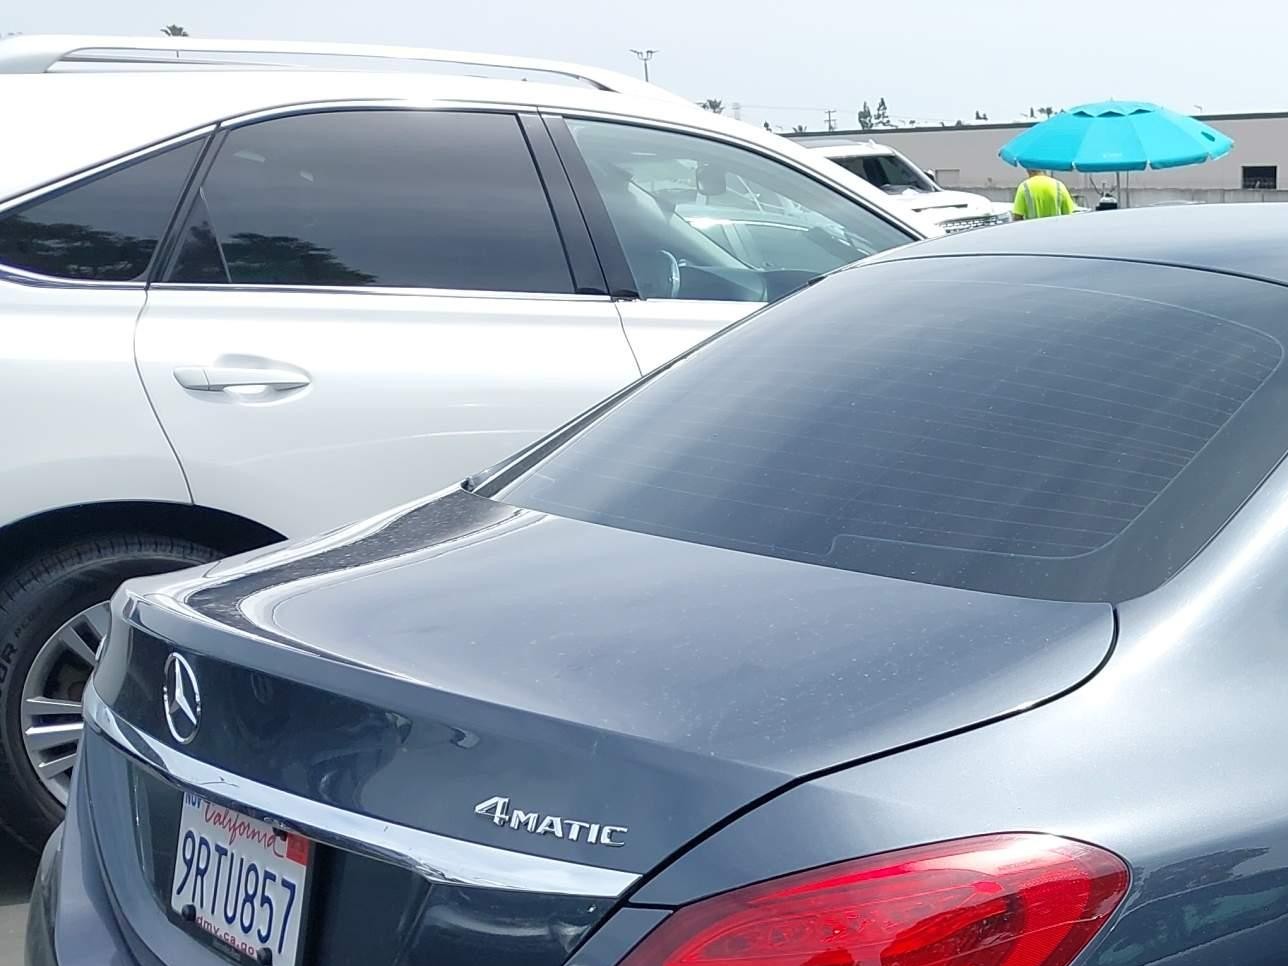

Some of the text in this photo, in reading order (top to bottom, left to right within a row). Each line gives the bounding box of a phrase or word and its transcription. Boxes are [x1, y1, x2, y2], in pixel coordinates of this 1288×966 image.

[203, 801, 284, 858] California
[474, 796, 628, 846] 4MATIC
[176, 829, 297, 955] 9RTU857
[195, 915, 256, 956] dmv.ca.go
